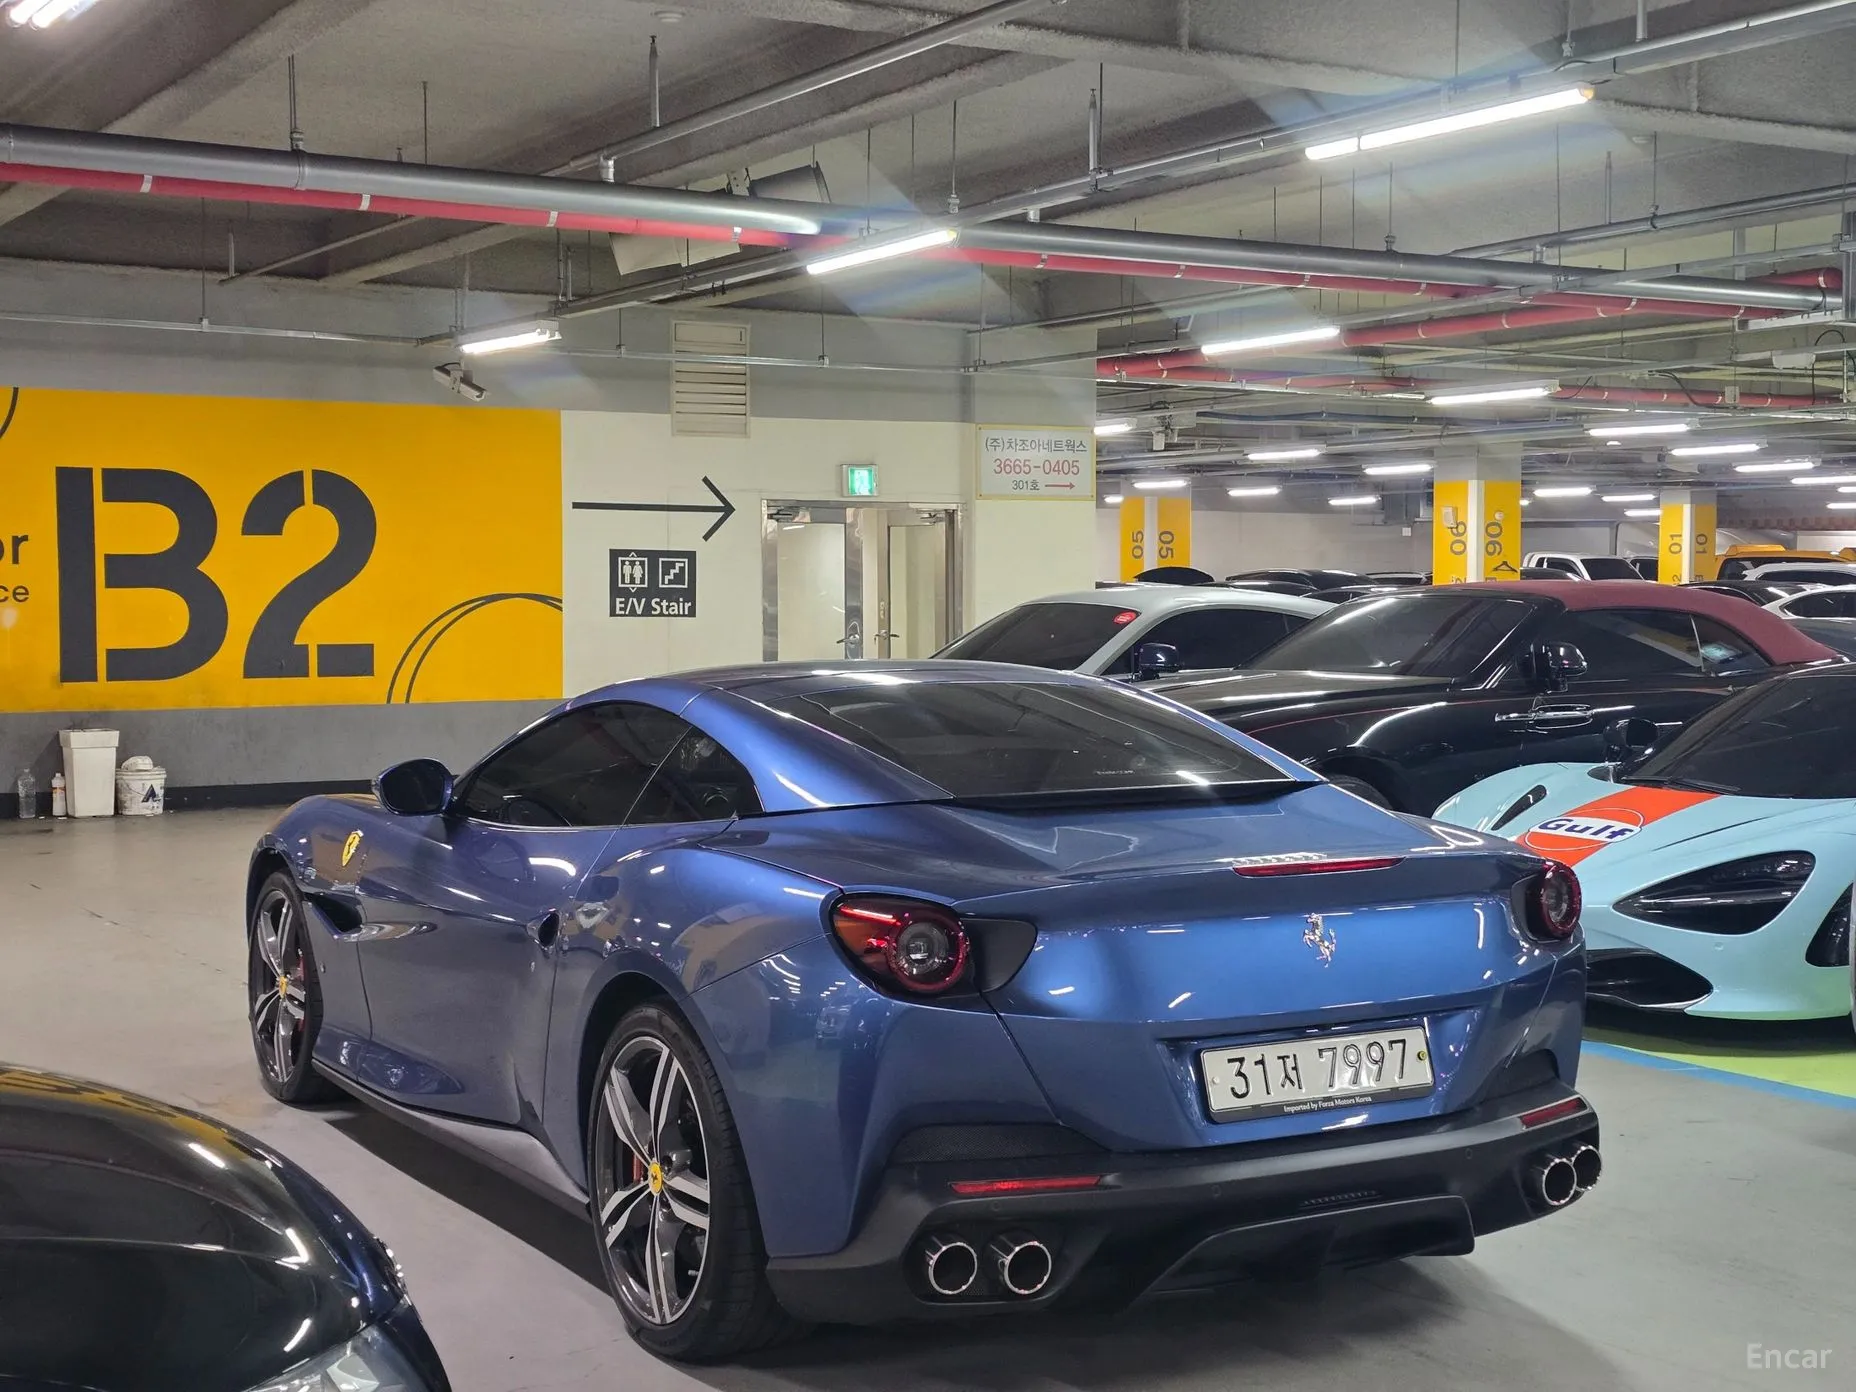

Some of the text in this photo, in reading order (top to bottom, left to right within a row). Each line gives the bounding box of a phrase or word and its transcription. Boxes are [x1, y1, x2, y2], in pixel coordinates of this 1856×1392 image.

[985, 437, 1087, 453] (주)차조아네트웍스
[993, 458, 1080, 475] 3665-0405
[1012, 480, 1040, 491] 301호
[0, 535, 28, 564] r
[1131, 530, 1144, 559] 05
[1159, 530, 1175, 559] 05
[1450, 521, 1467, 556] 06
[1485, 521, 1503, 556] 06
[1668, 533, 1682, 555] 01
[1696, 533, 1708, 555] 01
[55, 466, 377, 682] B2
[615, 597, 692, 615] E/V Stair
[1538, 818, 1634, 840] Gulf
[1227, 1038, 1407, 1099] 31저 7997
[1283, 1102, 1310, 1114] Imported
[1310, 1101, 1318, 1111] by
[1335, 1098, 1355, 1106] Motors
[1355, 1096, 1372, 1104] Korea
